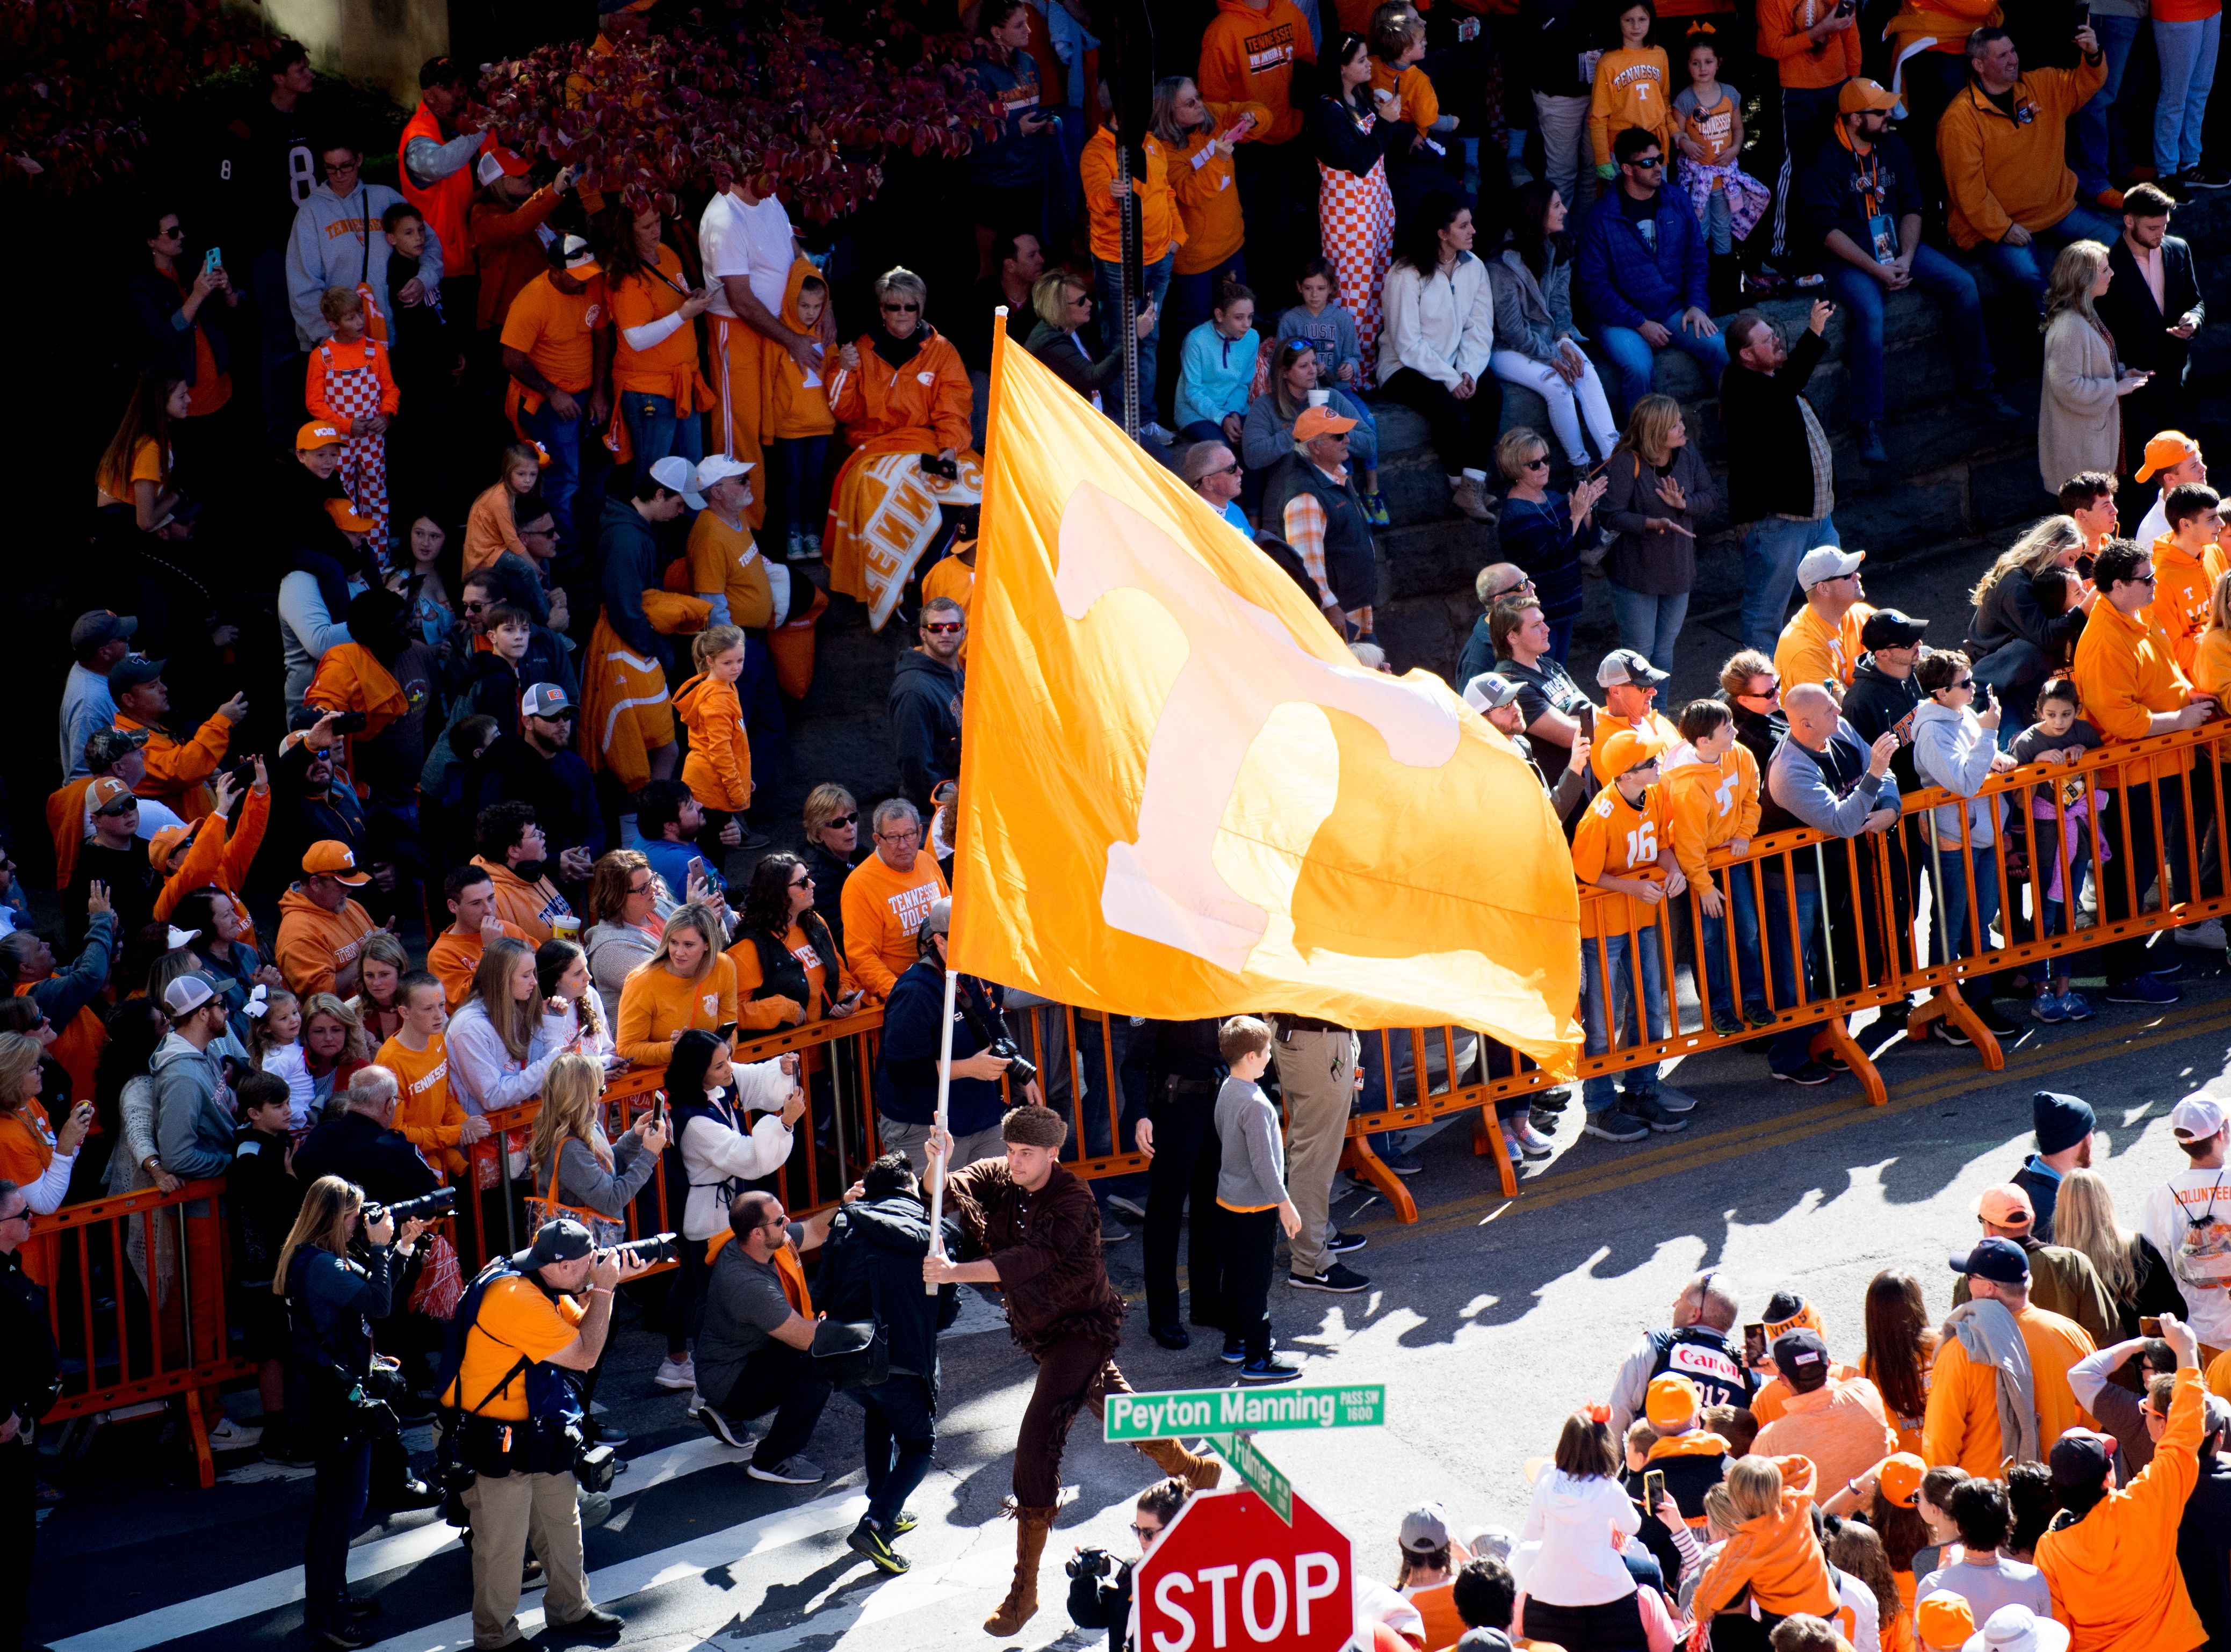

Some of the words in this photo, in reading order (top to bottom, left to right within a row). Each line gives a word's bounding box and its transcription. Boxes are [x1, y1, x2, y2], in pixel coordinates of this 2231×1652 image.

[1636, 83, 1649, 100] T
[1712, 140, 1724, 155] T
[221, 160, 231, 180] 8
[289, 146, 319, 208] 8
[1305, 323, 1336, 339] JUST
[2184, 586, 2194, 600] T
[104, 780, 124, 793] T
[1627, 821, 1658, 869] 16
[1680, 1350, 1741, 1379] Canon
[1114, 1397, 1211, 1436] Peyton
[1222, 1391, 1335, 1428] Manning
[1340, 1392, 1361, 1406] PASS
[1364, 1390, 1379, 1404] SW
[1346, 1408, 1374, 1422] 1600
[1234, 1438, 1272, 1494] Fulmer
[1152, 1551, 1340, 1652] STOP
